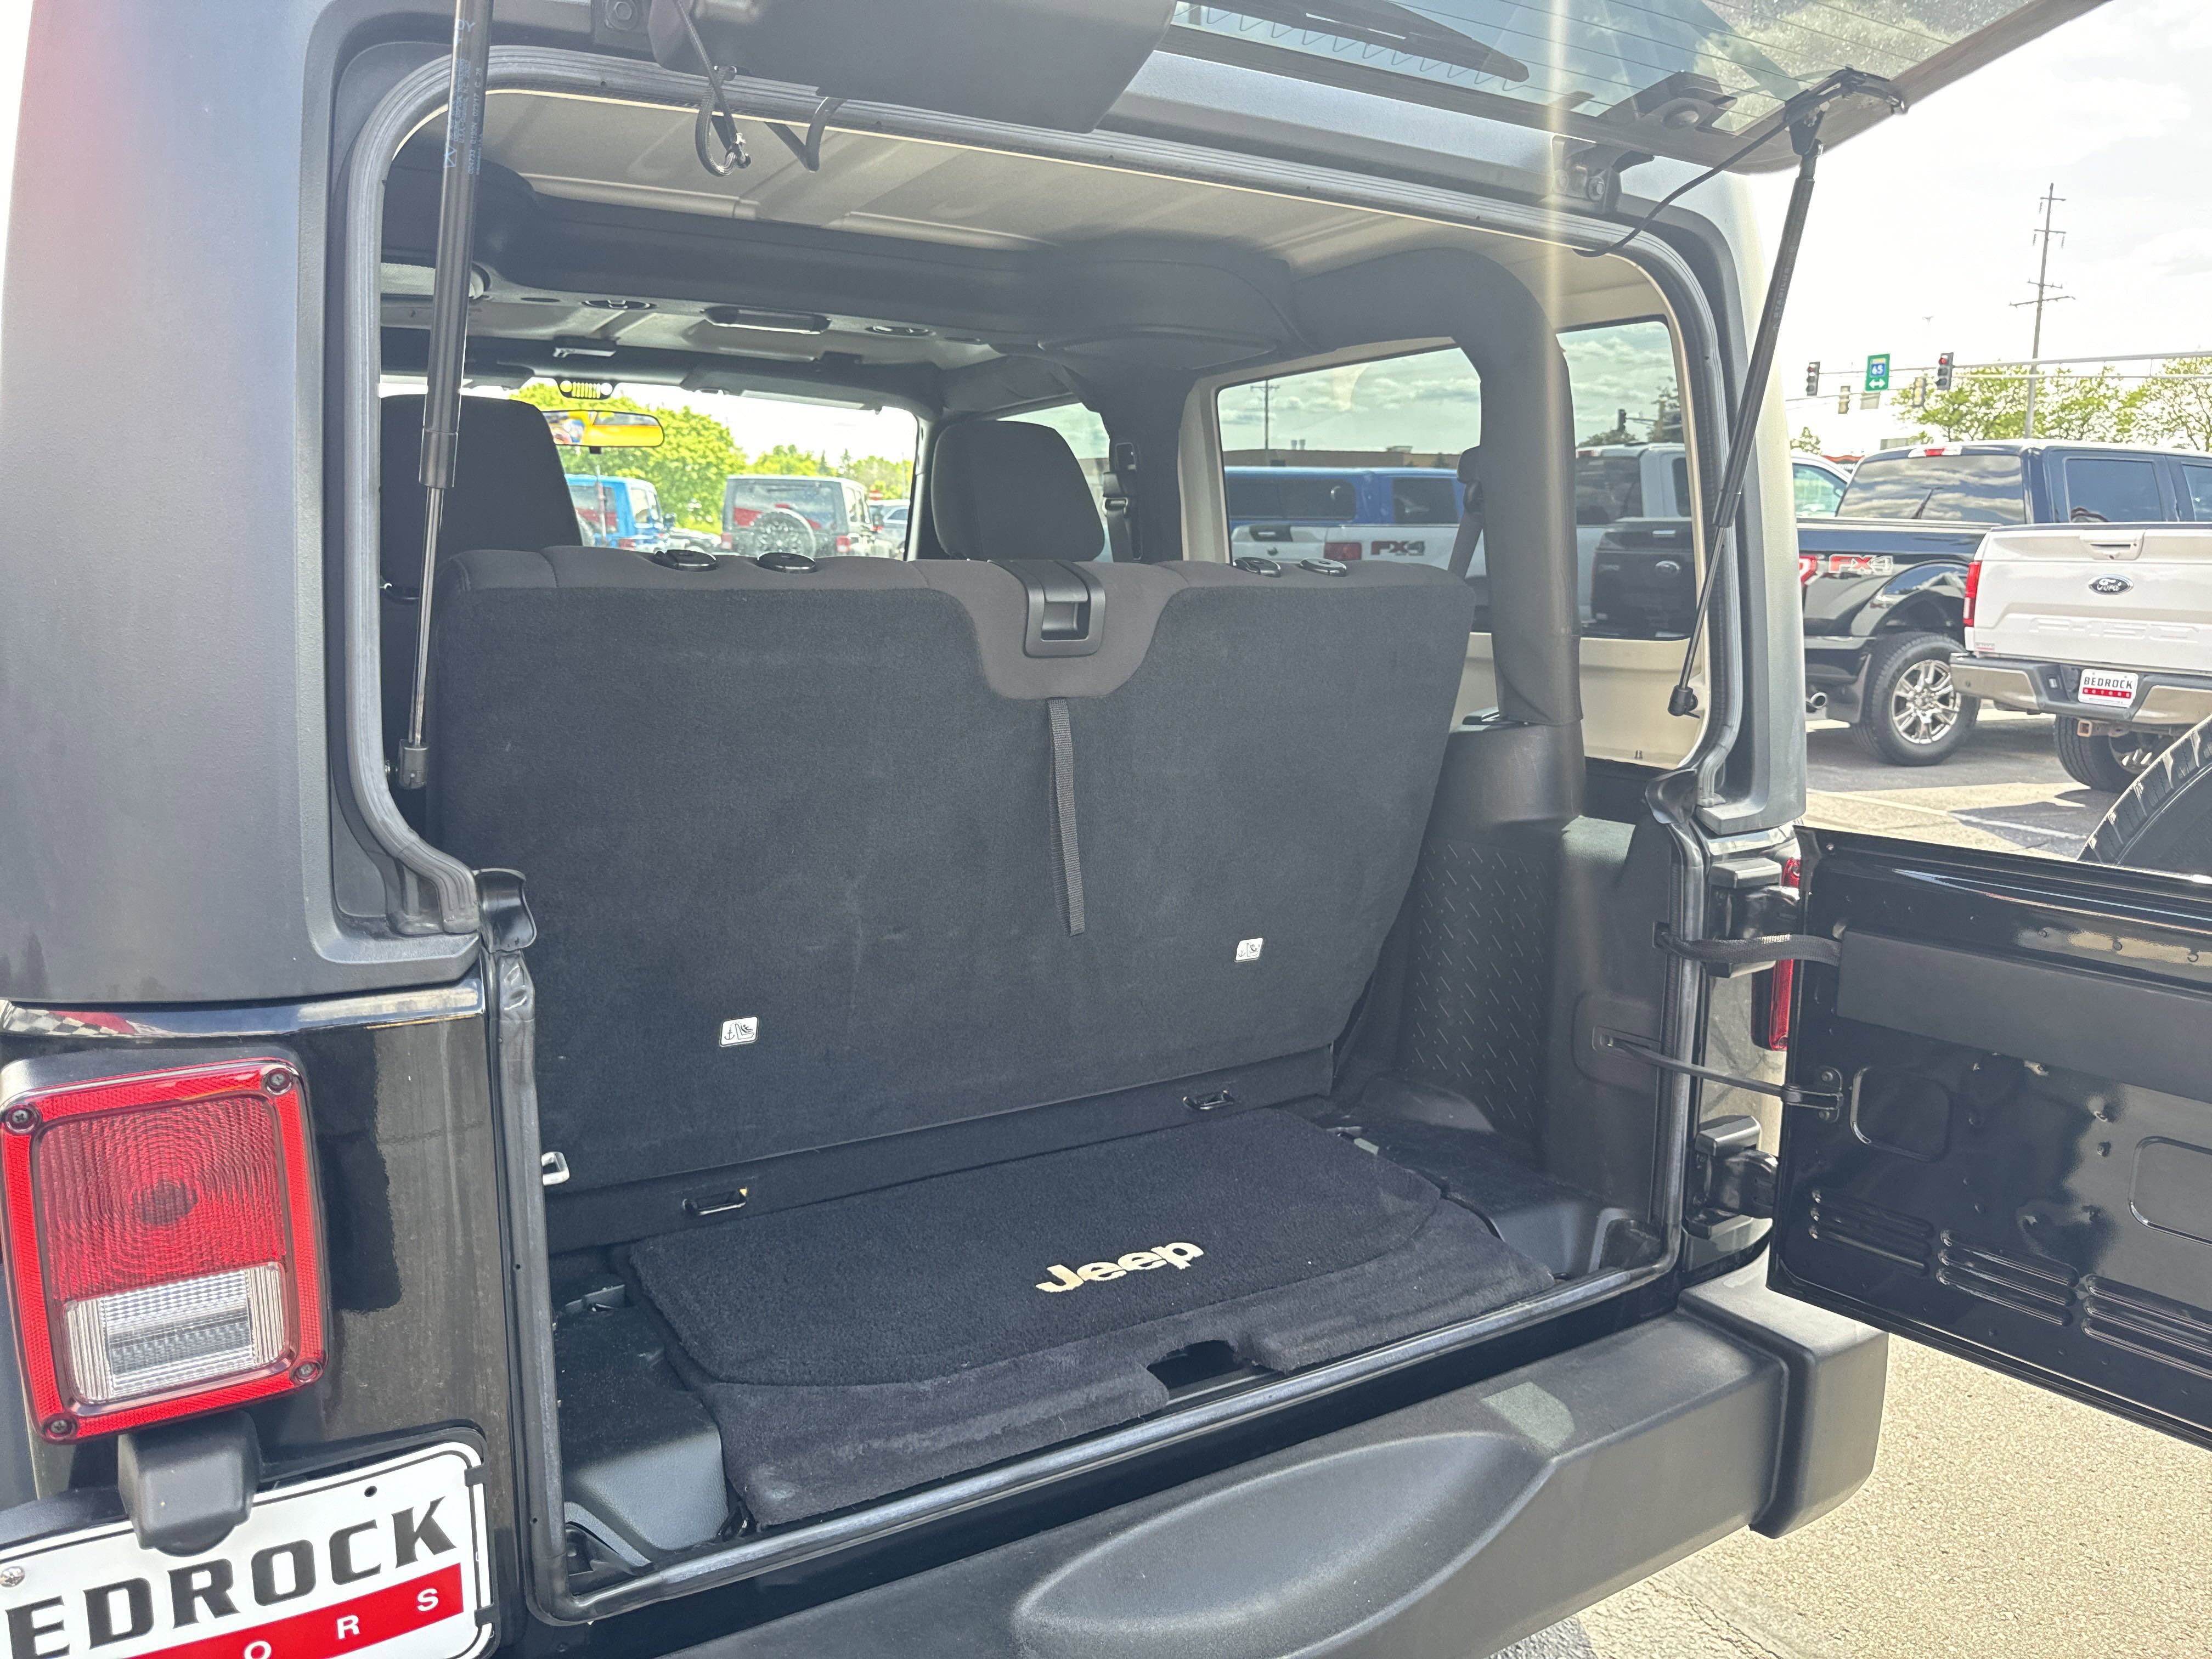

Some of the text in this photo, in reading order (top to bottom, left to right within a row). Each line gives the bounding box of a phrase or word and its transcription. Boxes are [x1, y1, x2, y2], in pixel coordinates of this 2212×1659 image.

[1370, 540, 1426, 556] FX4
[1829, 554, 1893, 576] FX4
[2084, 676, 2133, 690] BEDROCK
[1035, 1242, 1205, 1293] Jeep
